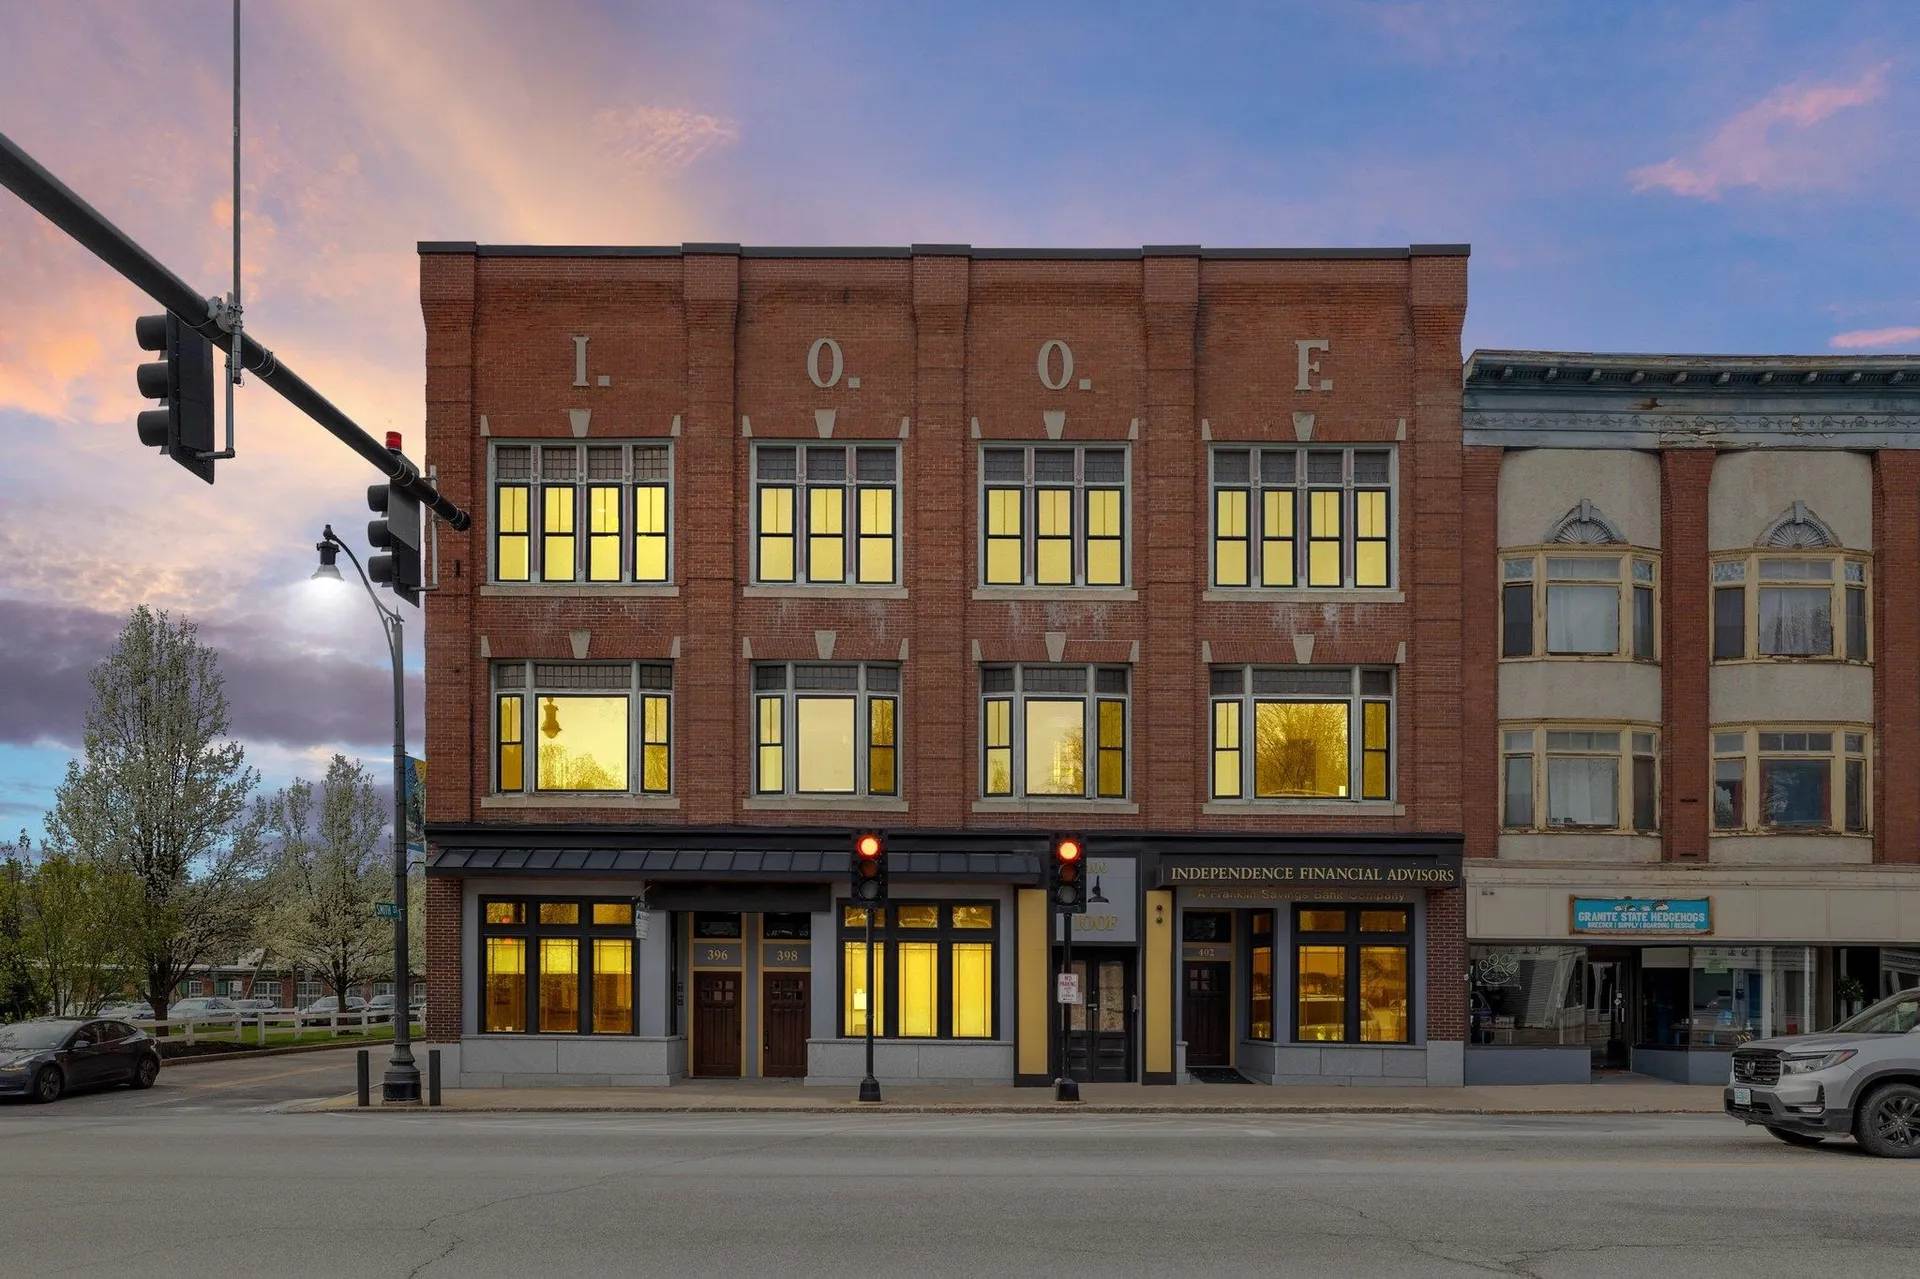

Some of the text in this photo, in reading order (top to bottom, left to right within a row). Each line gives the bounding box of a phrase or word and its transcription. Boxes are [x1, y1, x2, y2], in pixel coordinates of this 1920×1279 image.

[572, 336, 1333, 390] I. O. O. F.
[1171, 867, 1455, 882] INDEPENDENCE FINANCIAL ADVISORS
[1197, 888, 1406, 902] A Franklin Savings Bank Company
[1578, 912, 1705, 922] GRANITE STATE HEDGEHOGS
[1617, 921, 1639, 929] SUPPLY
[707, 949, 728, 961] 396
[776, 950, 798, 961] 398
[1198, 948, 1215, 957] 402
